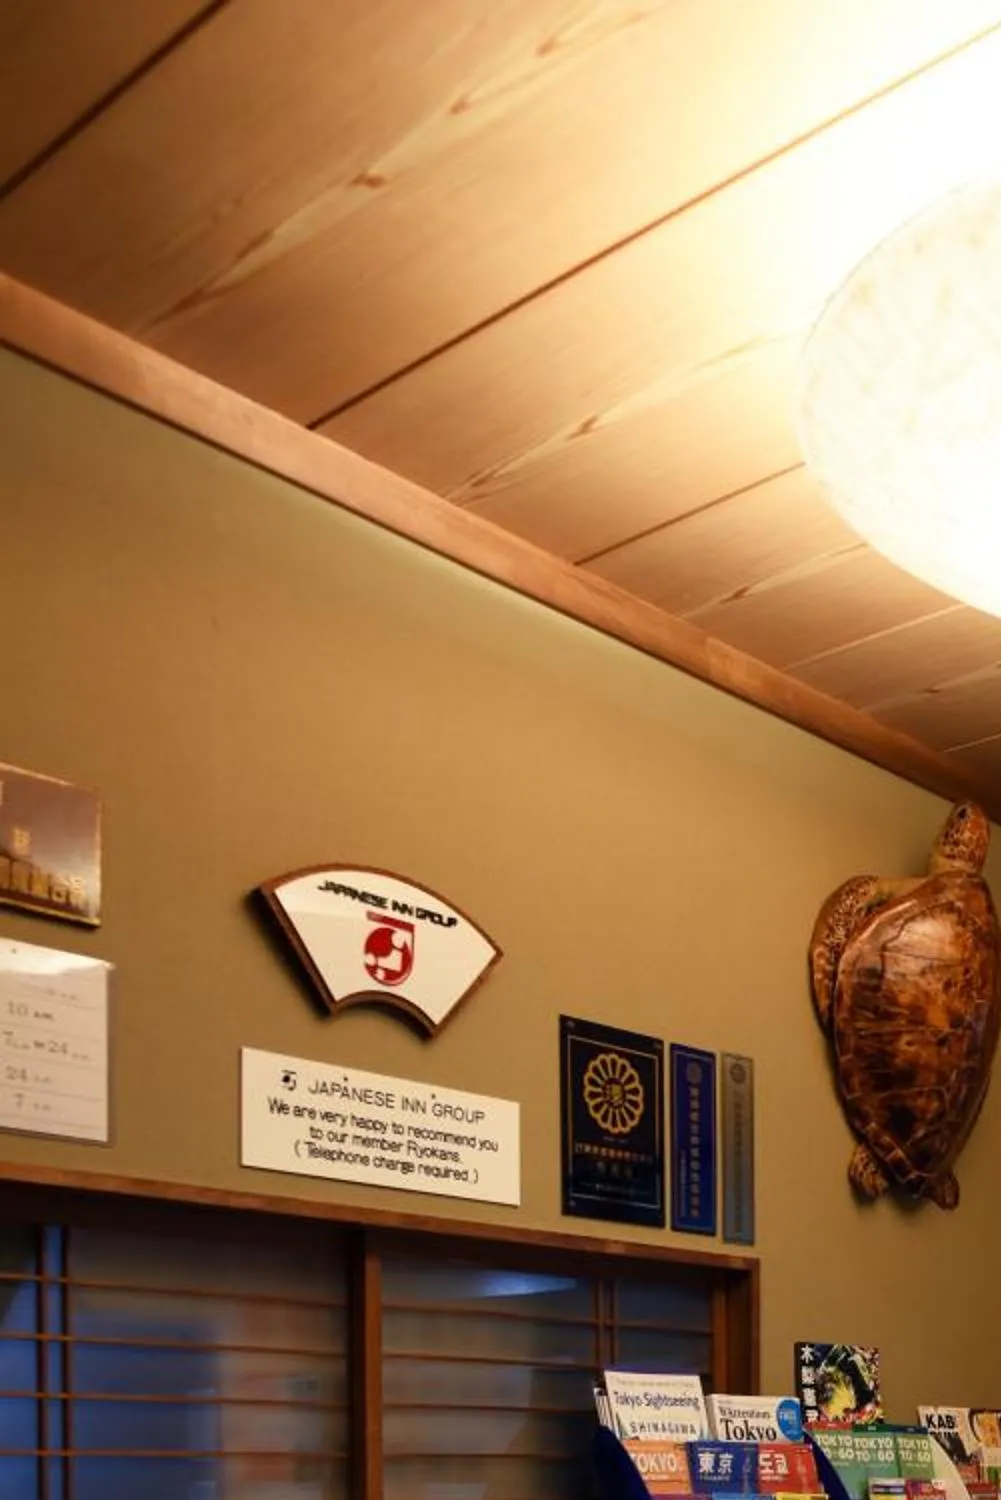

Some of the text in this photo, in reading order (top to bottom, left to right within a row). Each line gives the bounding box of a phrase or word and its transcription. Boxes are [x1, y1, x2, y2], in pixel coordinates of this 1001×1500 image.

[318, 880, 458, 928] JAPANESE INN GROUP
[308, 1079, 485, 1125] JAPANESE INN GROUP
[268, 1097, 498, 1152] We are very happy to recommend you
[309, 1125, 324, 1139] to
[327, 1129, 348, 1144] our
[352, 1131, 404, 1152] member
[372, 1153, 415, 1174] charge
[613, 1391, 700, 1412] Tokyo Sightseeing
[630, 1421, 697, 1435] SHINAGAWA
[720, 1419, 777, 1442] Tokyo
[817, 1434, 852, 1447] TOKYO
[854, 1437, 893, 1449] TOKYO
[897, 1437, 928, 1449] TOKYO
[698, 1452, 734, 1474] 東京
